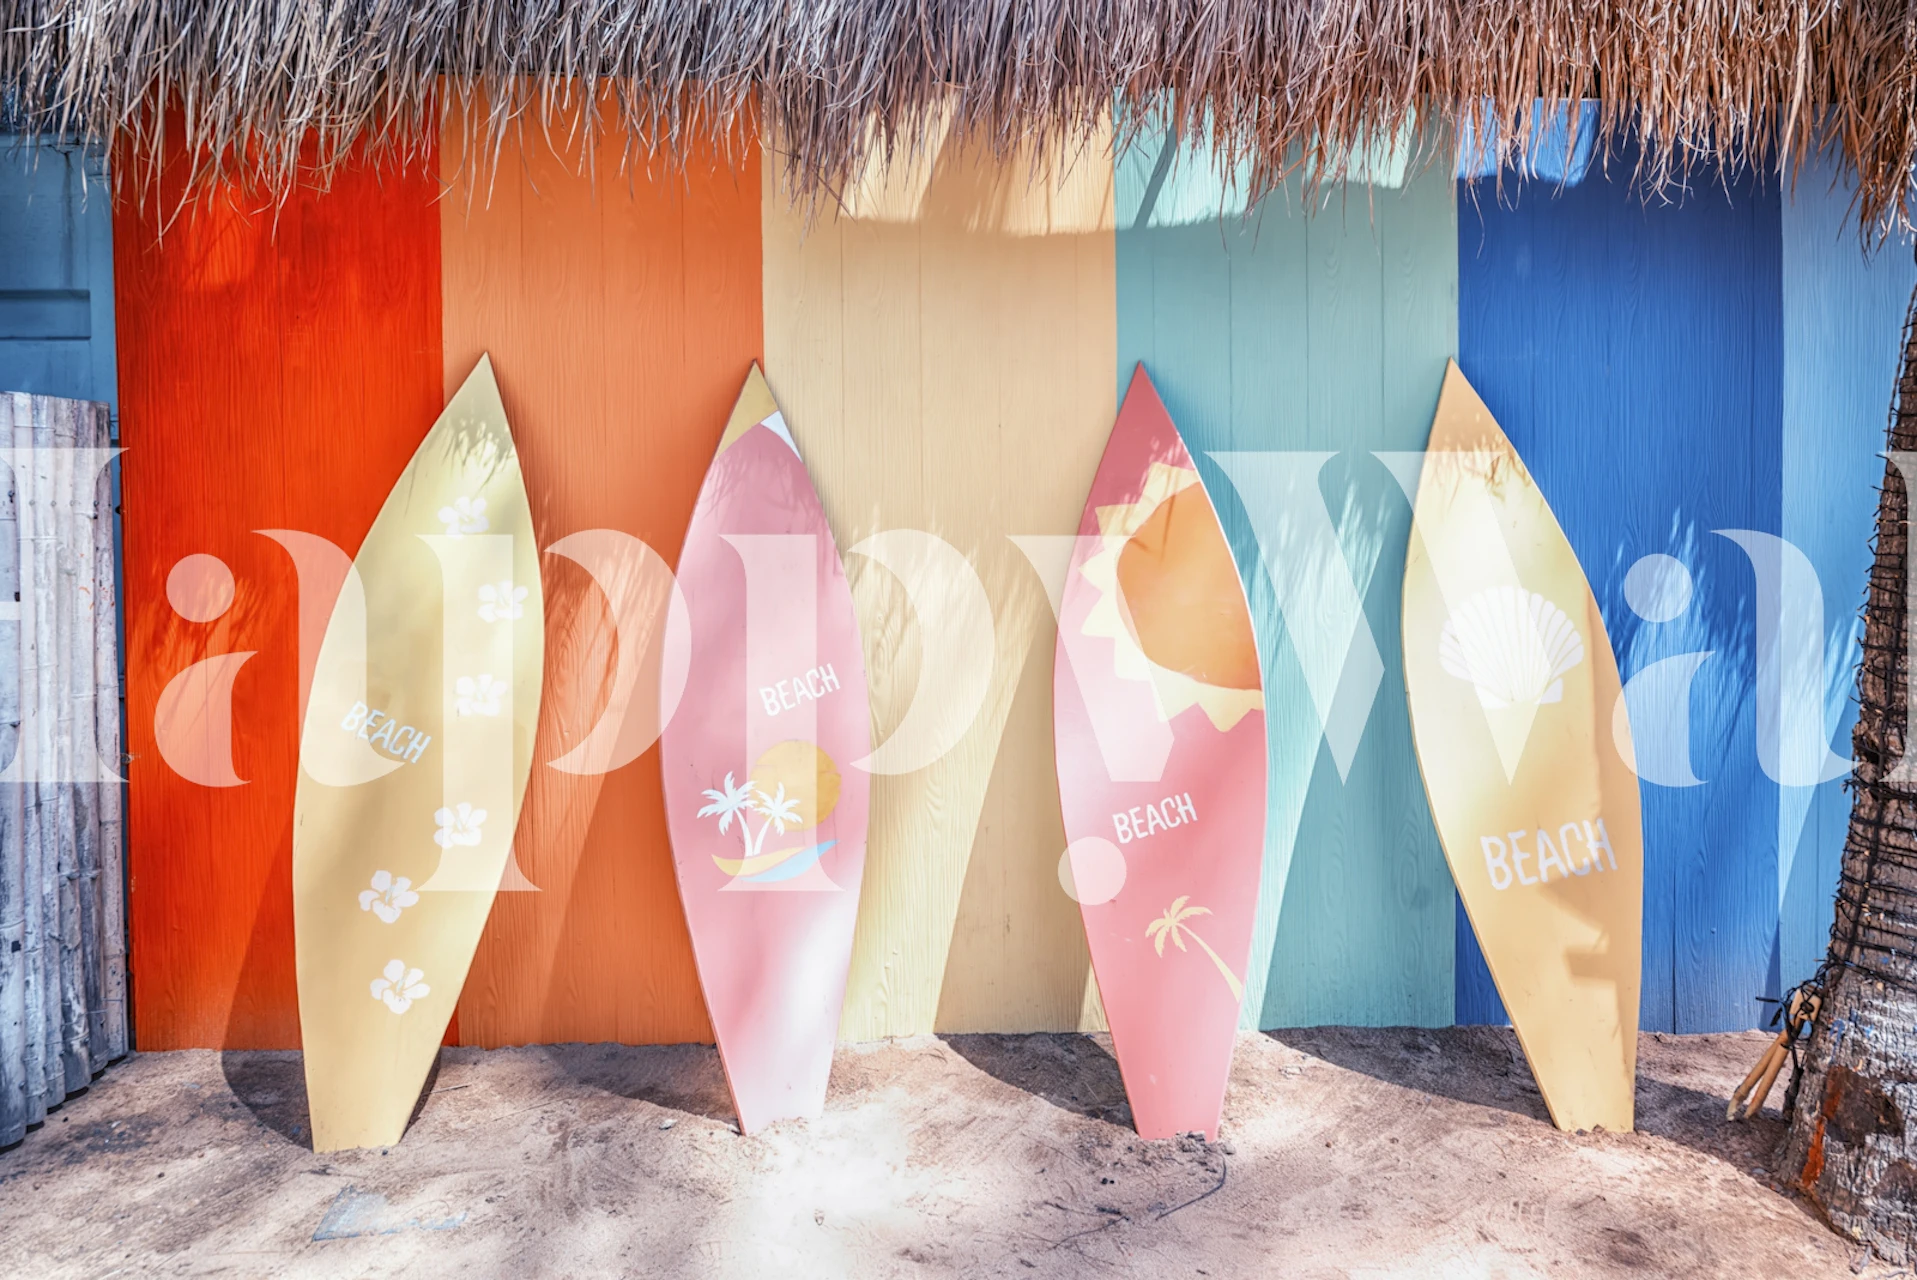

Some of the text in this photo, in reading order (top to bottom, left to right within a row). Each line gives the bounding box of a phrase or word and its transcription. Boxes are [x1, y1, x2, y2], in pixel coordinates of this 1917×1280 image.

[759, 662, 841, 717] BEACH
[341, 700, 432, 764] BEACH
[1111, 791, 1198, 844] BEACH
[1480, 817, 1618, 890] BEACH
